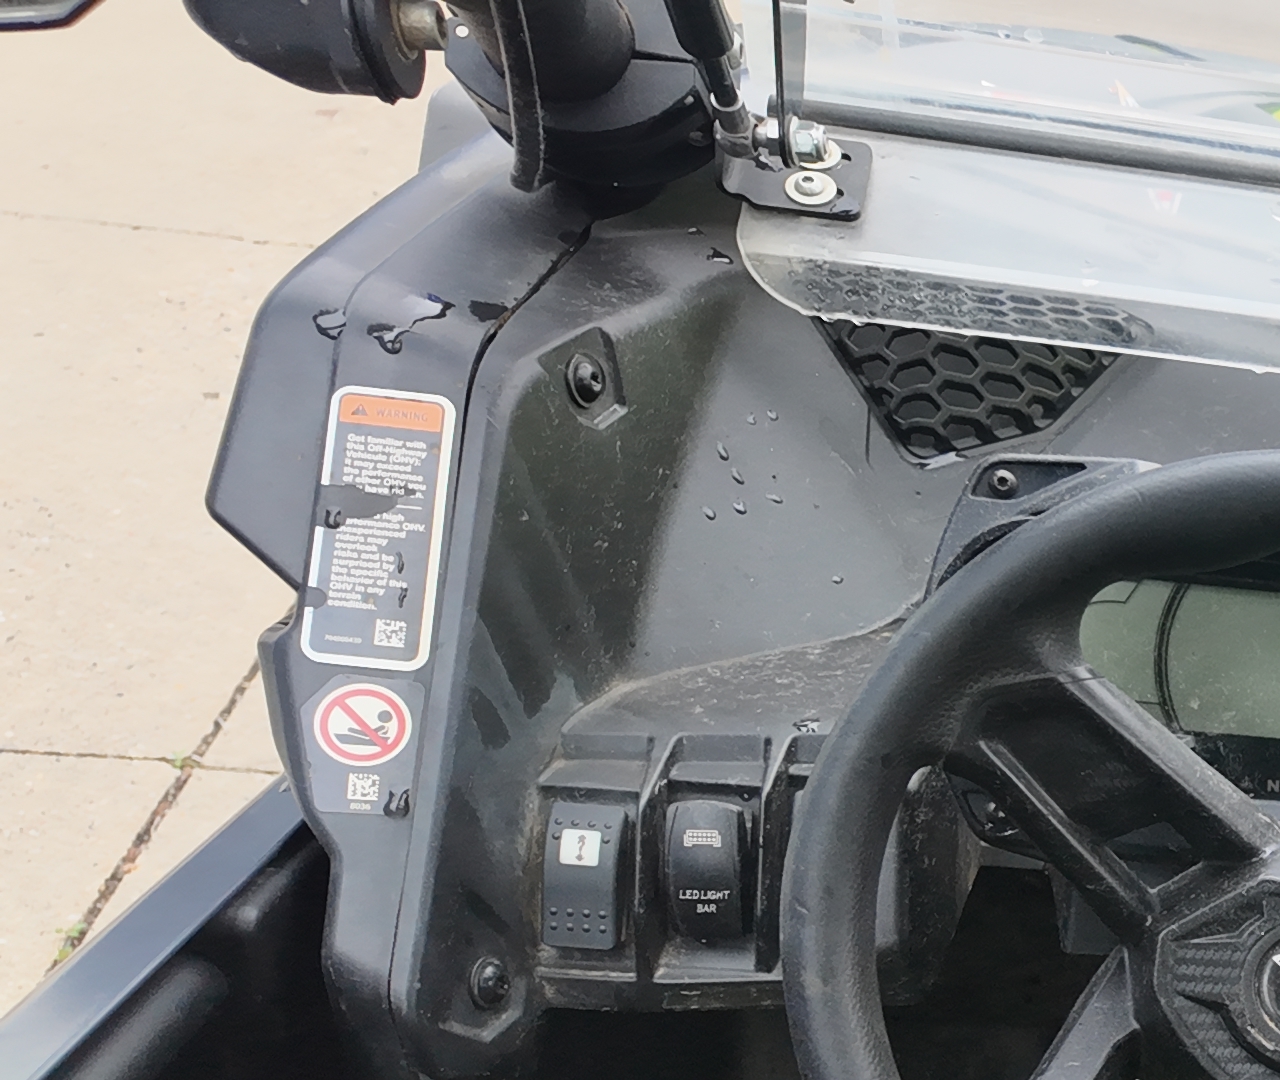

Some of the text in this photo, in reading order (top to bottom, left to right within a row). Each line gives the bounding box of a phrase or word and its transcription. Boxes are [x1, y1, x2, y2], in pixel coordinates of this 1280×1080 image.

[377, 409, 428, 421] WARNING
[347, 442, 365, 451] this
[348, 433, 427, 449] Get familiar with
[354, 461, 375, 469] may
[377, 463, 412, 473] exceed
[344, 467, 424, 482] the performance
[355, 477, 381, 485] other
[384, 478, 406, 487] OHV
[408, 483, 427, 491] you
[383, 512, 404, 522] high
[336, 534, 389, 547] riders may
[334, 542, 378, 552] overlook
[334, 550, 395, 562] risks and be
[333, 559, 395, 572] surprised by
[332, 566, 389, 578] the specific
[330, 582, 386, 597] OHV in any
[377, 578, 388, 587] of
[389, 580, 408, 589] this
[329, 590, 362, 600] terrain
[1267, 779, 1280, 793] N
[679, 890, 731, 900] LED LIGHT
[697, 904, 717, 914] BAR
